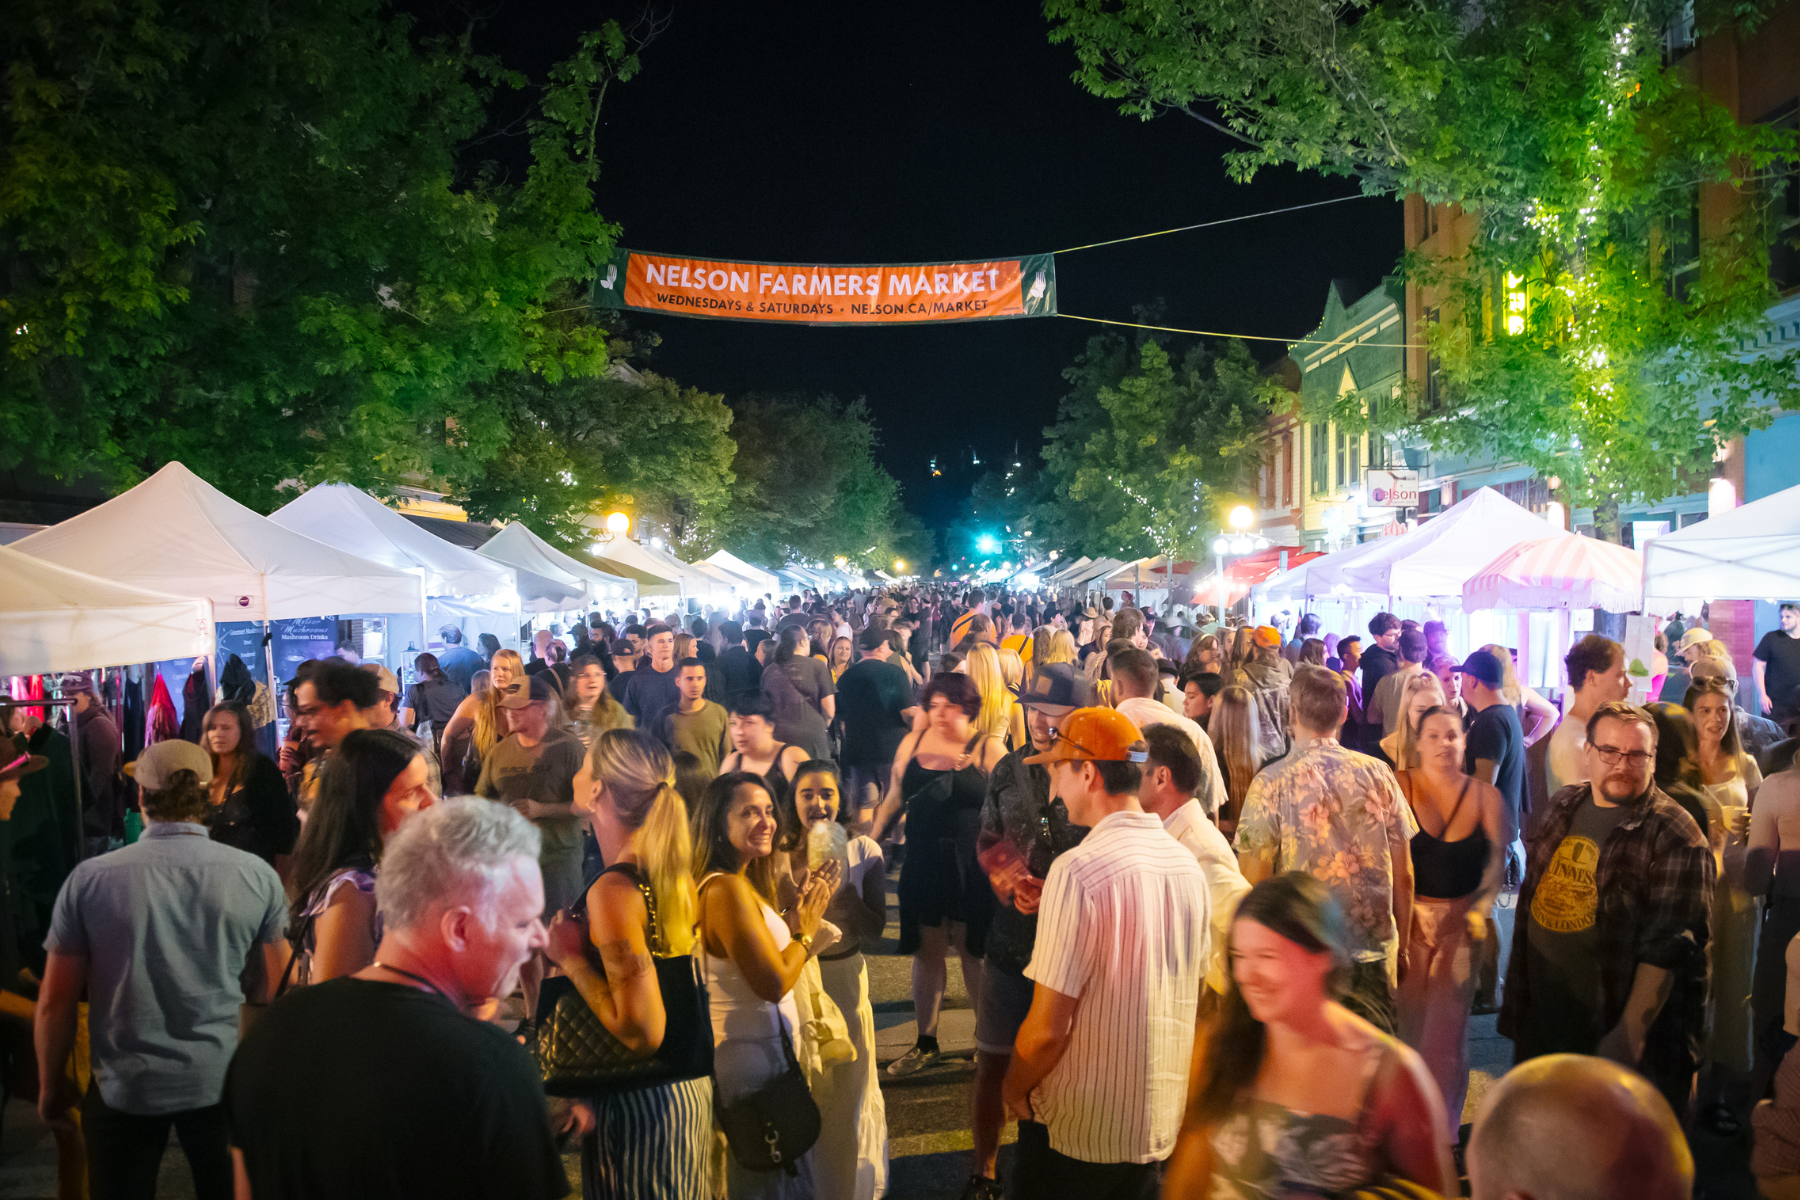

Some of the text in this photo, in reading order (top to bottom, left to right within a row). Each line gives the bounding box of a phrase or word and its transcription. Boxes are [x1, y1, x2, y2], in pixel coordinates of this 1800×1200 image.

[646, 263, 1000, 296] NELSON FARMERS MARKET
[657, 293, 989, 317] WEDNESDAYS & SATURDAYS NELSON.CA/MARKET
[1374, 488, 1417, 502] elson
